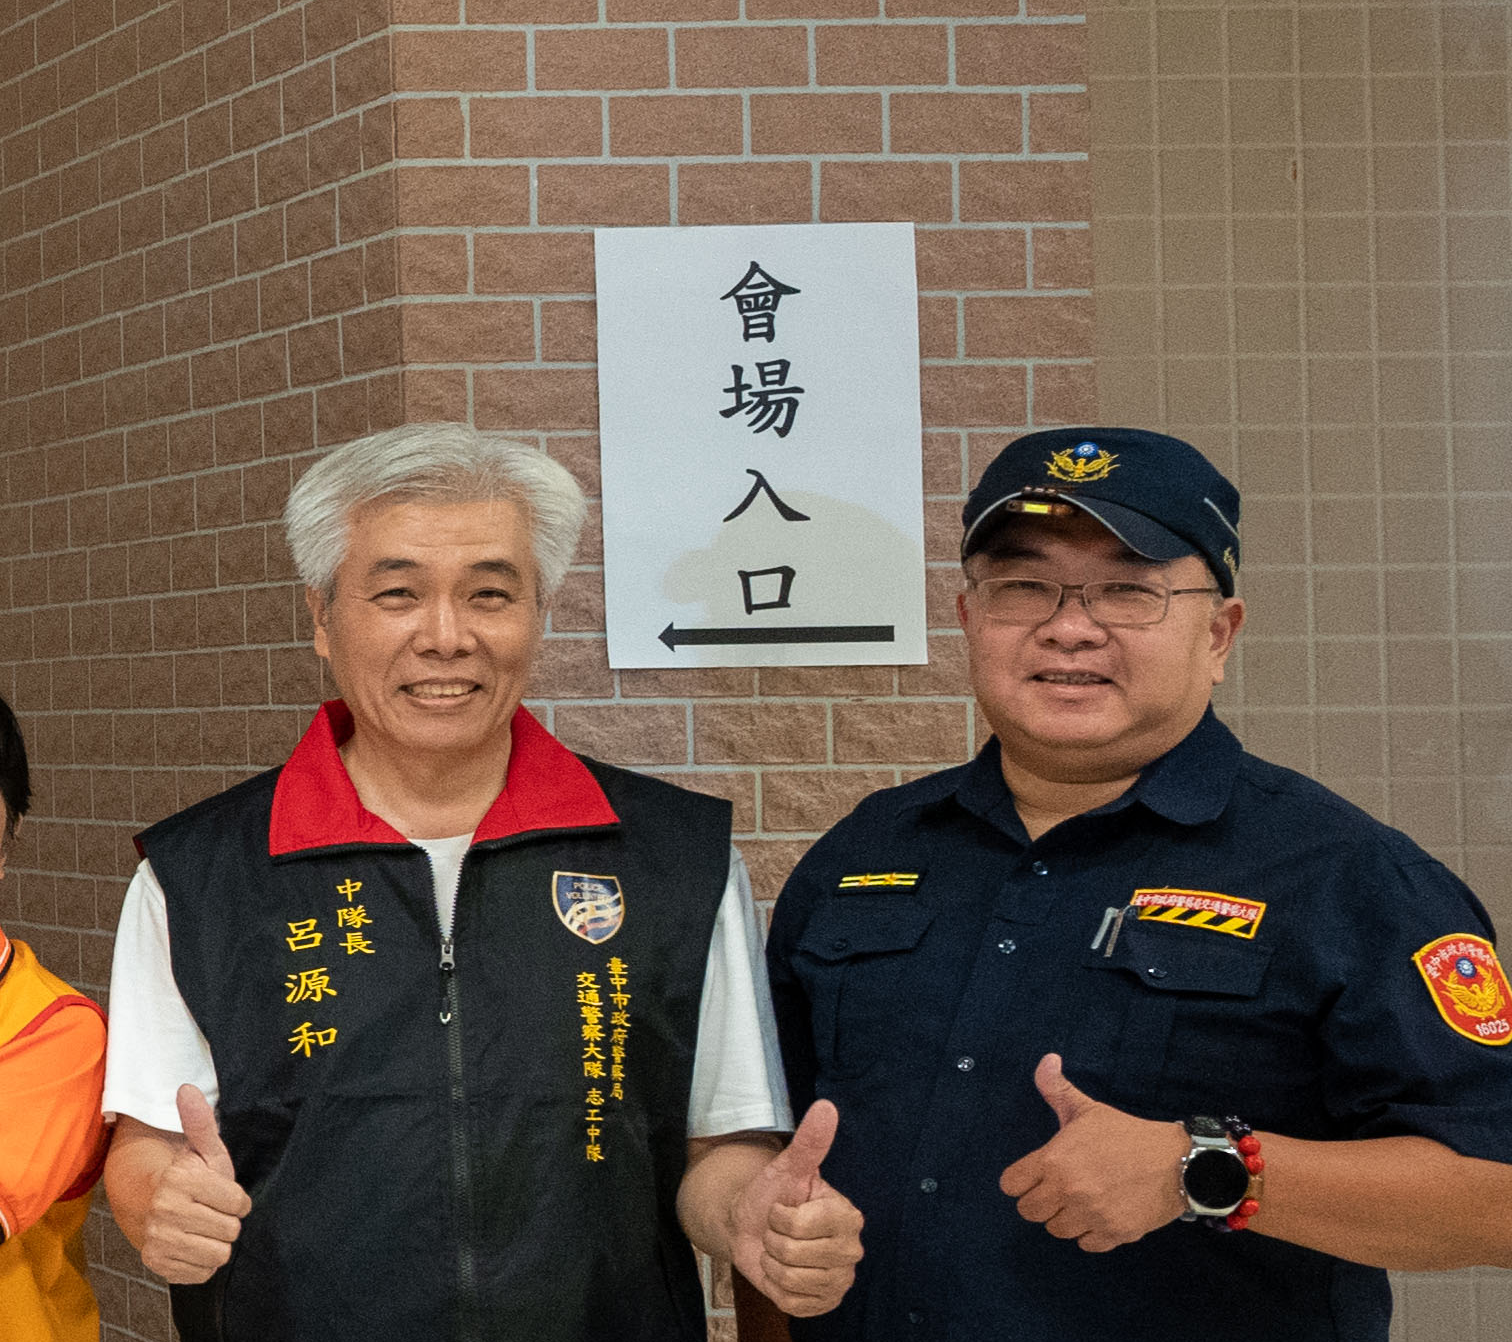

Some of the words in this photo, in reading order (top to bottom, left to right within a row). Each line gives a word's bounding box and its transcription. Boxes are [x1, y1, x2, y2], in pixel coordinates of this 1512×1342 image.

[718, 261, 810, 615] 會場入口
[336, 879, 376, 954] 中隊長
[285, 918, 338, 1058] 呂源和
[576, 972, 606, 1078] 交通警察大隊
[607, 956, 631, 1101] 臺中市政府警察局
[585, 1088, 604, 1162] 志工中隊
